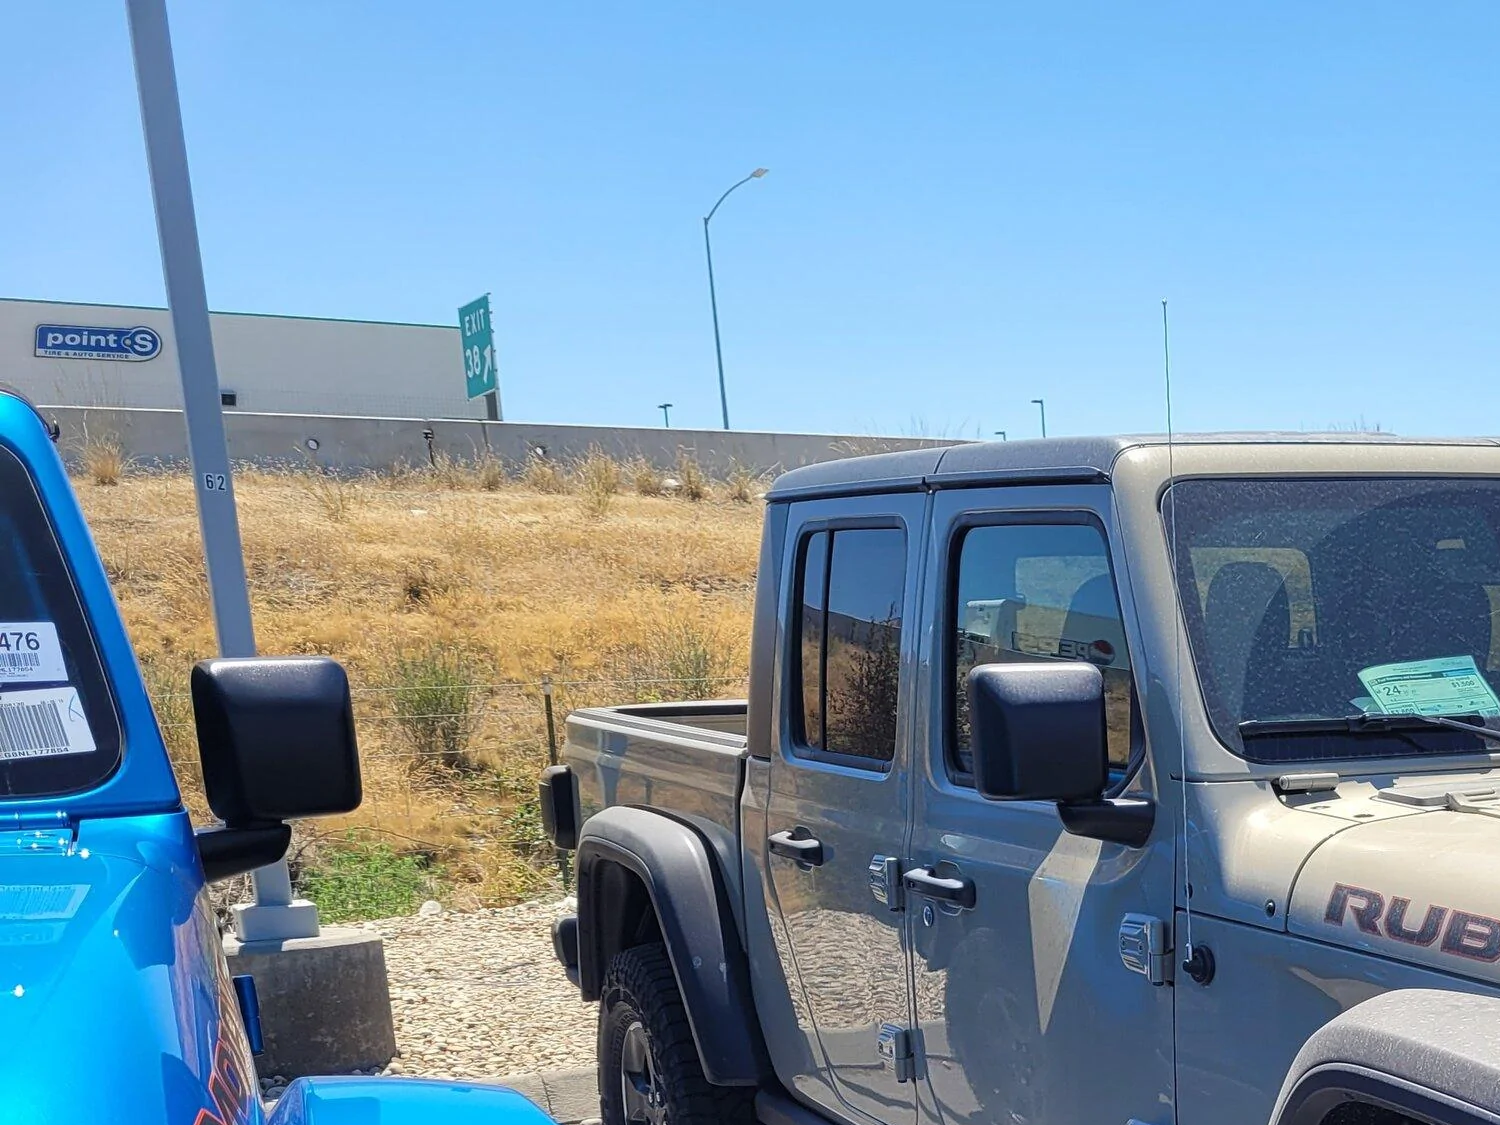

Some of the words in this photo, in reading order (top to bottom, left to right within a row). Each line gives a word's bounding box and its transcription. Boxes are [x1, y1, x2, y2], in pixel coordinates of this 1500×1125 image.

[464, 308, 485, 337] EXIT
[46, 331, 118, 347] point
[133, 333, 153, 352] S
[96, 352, 130, 360] SERVICE
[465, 345, 481, 378] 38
[205, 474, 226, 491] 62
[1382, 685, 1402, 697] 24
